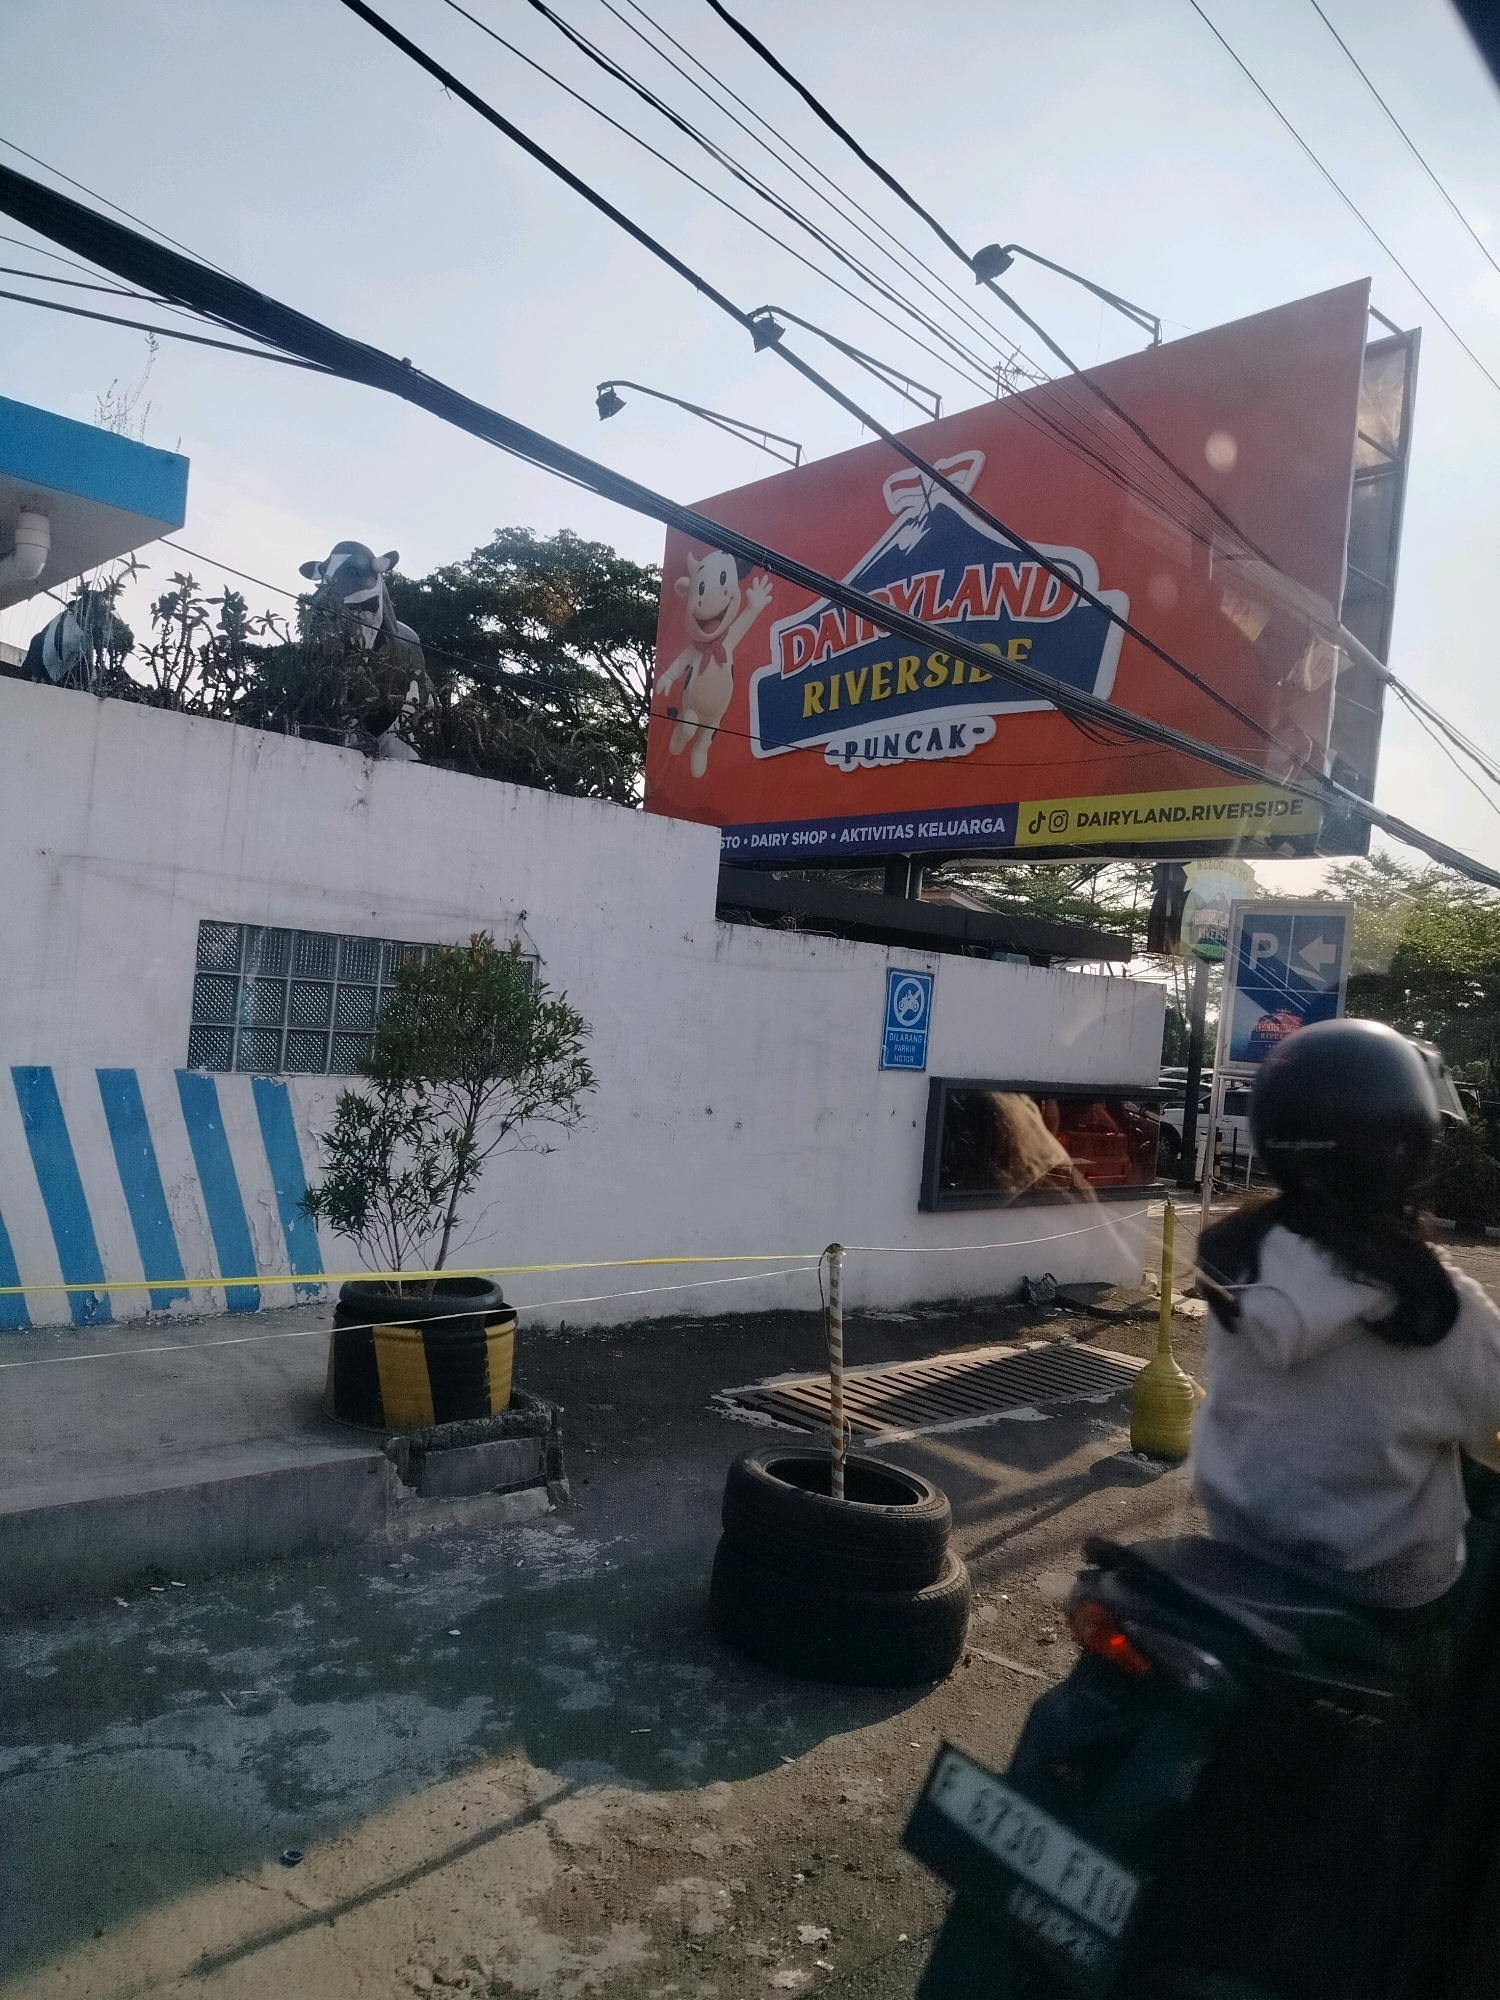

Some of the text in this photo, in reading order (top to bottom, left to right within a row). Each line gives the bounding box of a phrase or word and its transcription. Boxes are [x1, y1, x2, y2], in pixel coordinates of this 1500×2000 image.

[1076, 799, 1304, 828] DAIRYLAND.RIVERSIDE
[719, 817, 1006, 849] STO DAIRY SHOP AKTIVITAS KELUARGA
[1196, 859, 1249, 881] WELCOME TO
[1198, 928, 1227, 942] RIVERSI
[1248, 932, 1279, 970] P
[889, 1032, 923, 1044] DILARANG
[893, 1044, 916, 1053] PARKIR
[893, 1054, 914, 1063] MOTOR
